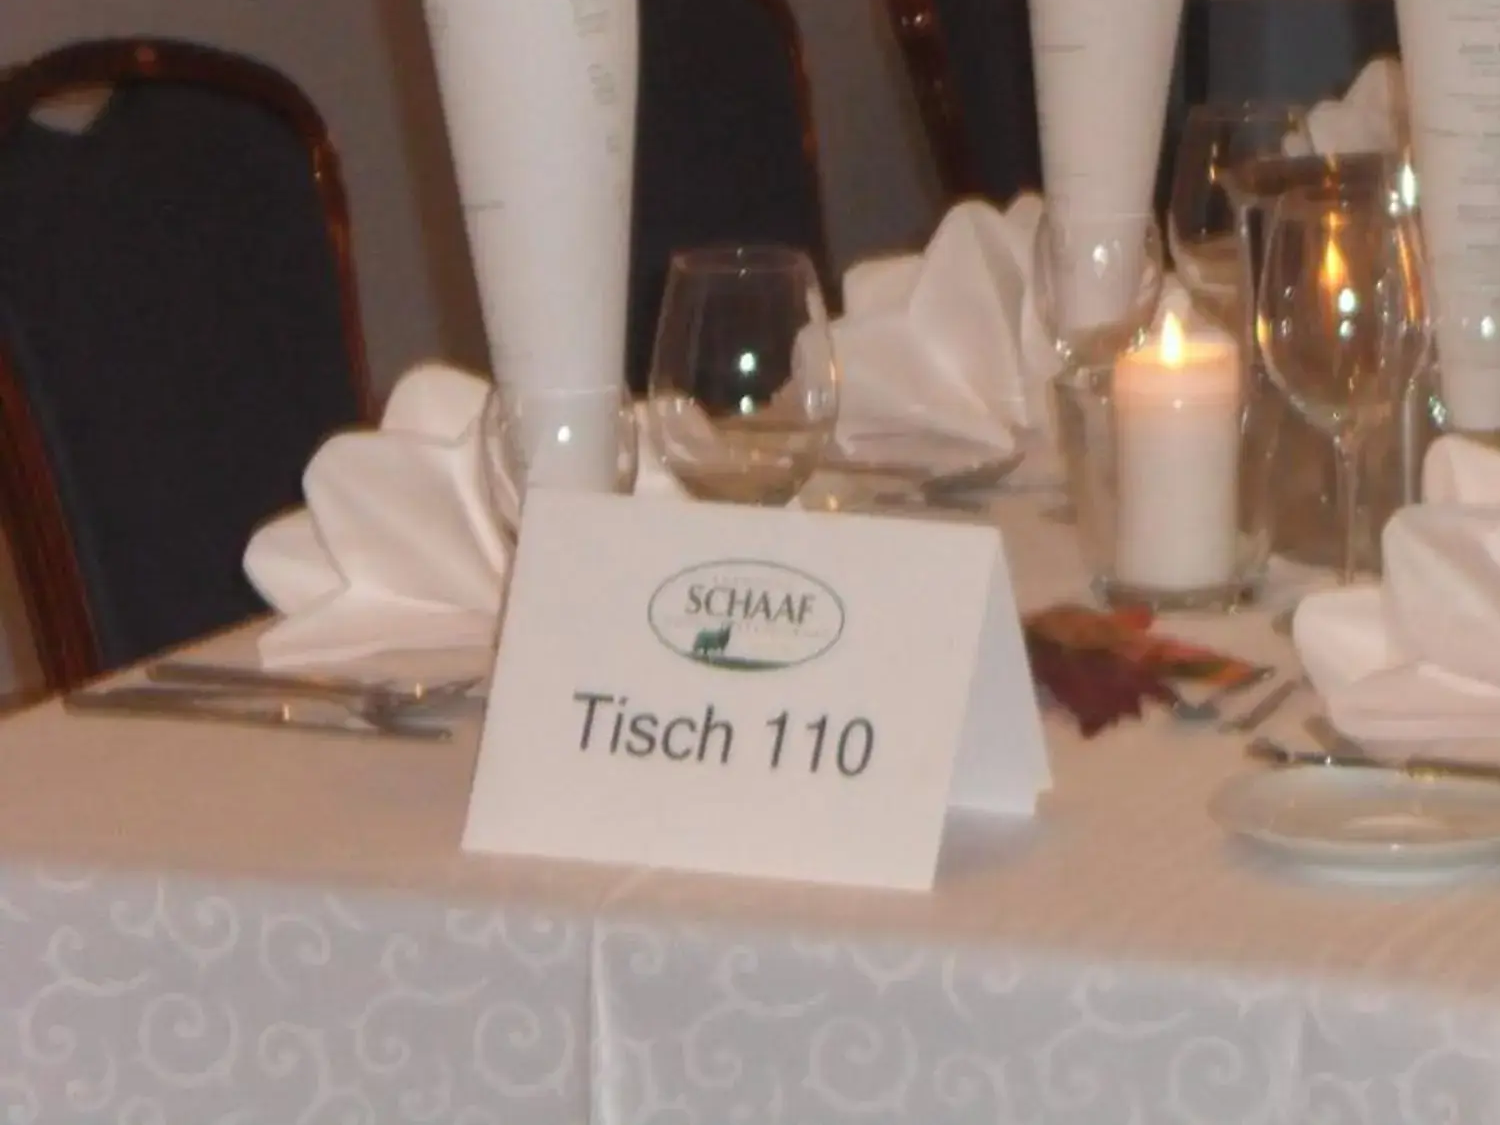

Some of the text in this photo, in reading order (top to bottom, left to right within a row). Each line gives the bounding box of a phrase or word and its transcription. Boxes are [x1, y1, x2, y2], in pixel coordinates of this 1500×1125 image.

[684, 584, 816, 625] SCHAAF
[572, 692, 875, 778] Tisch 110
